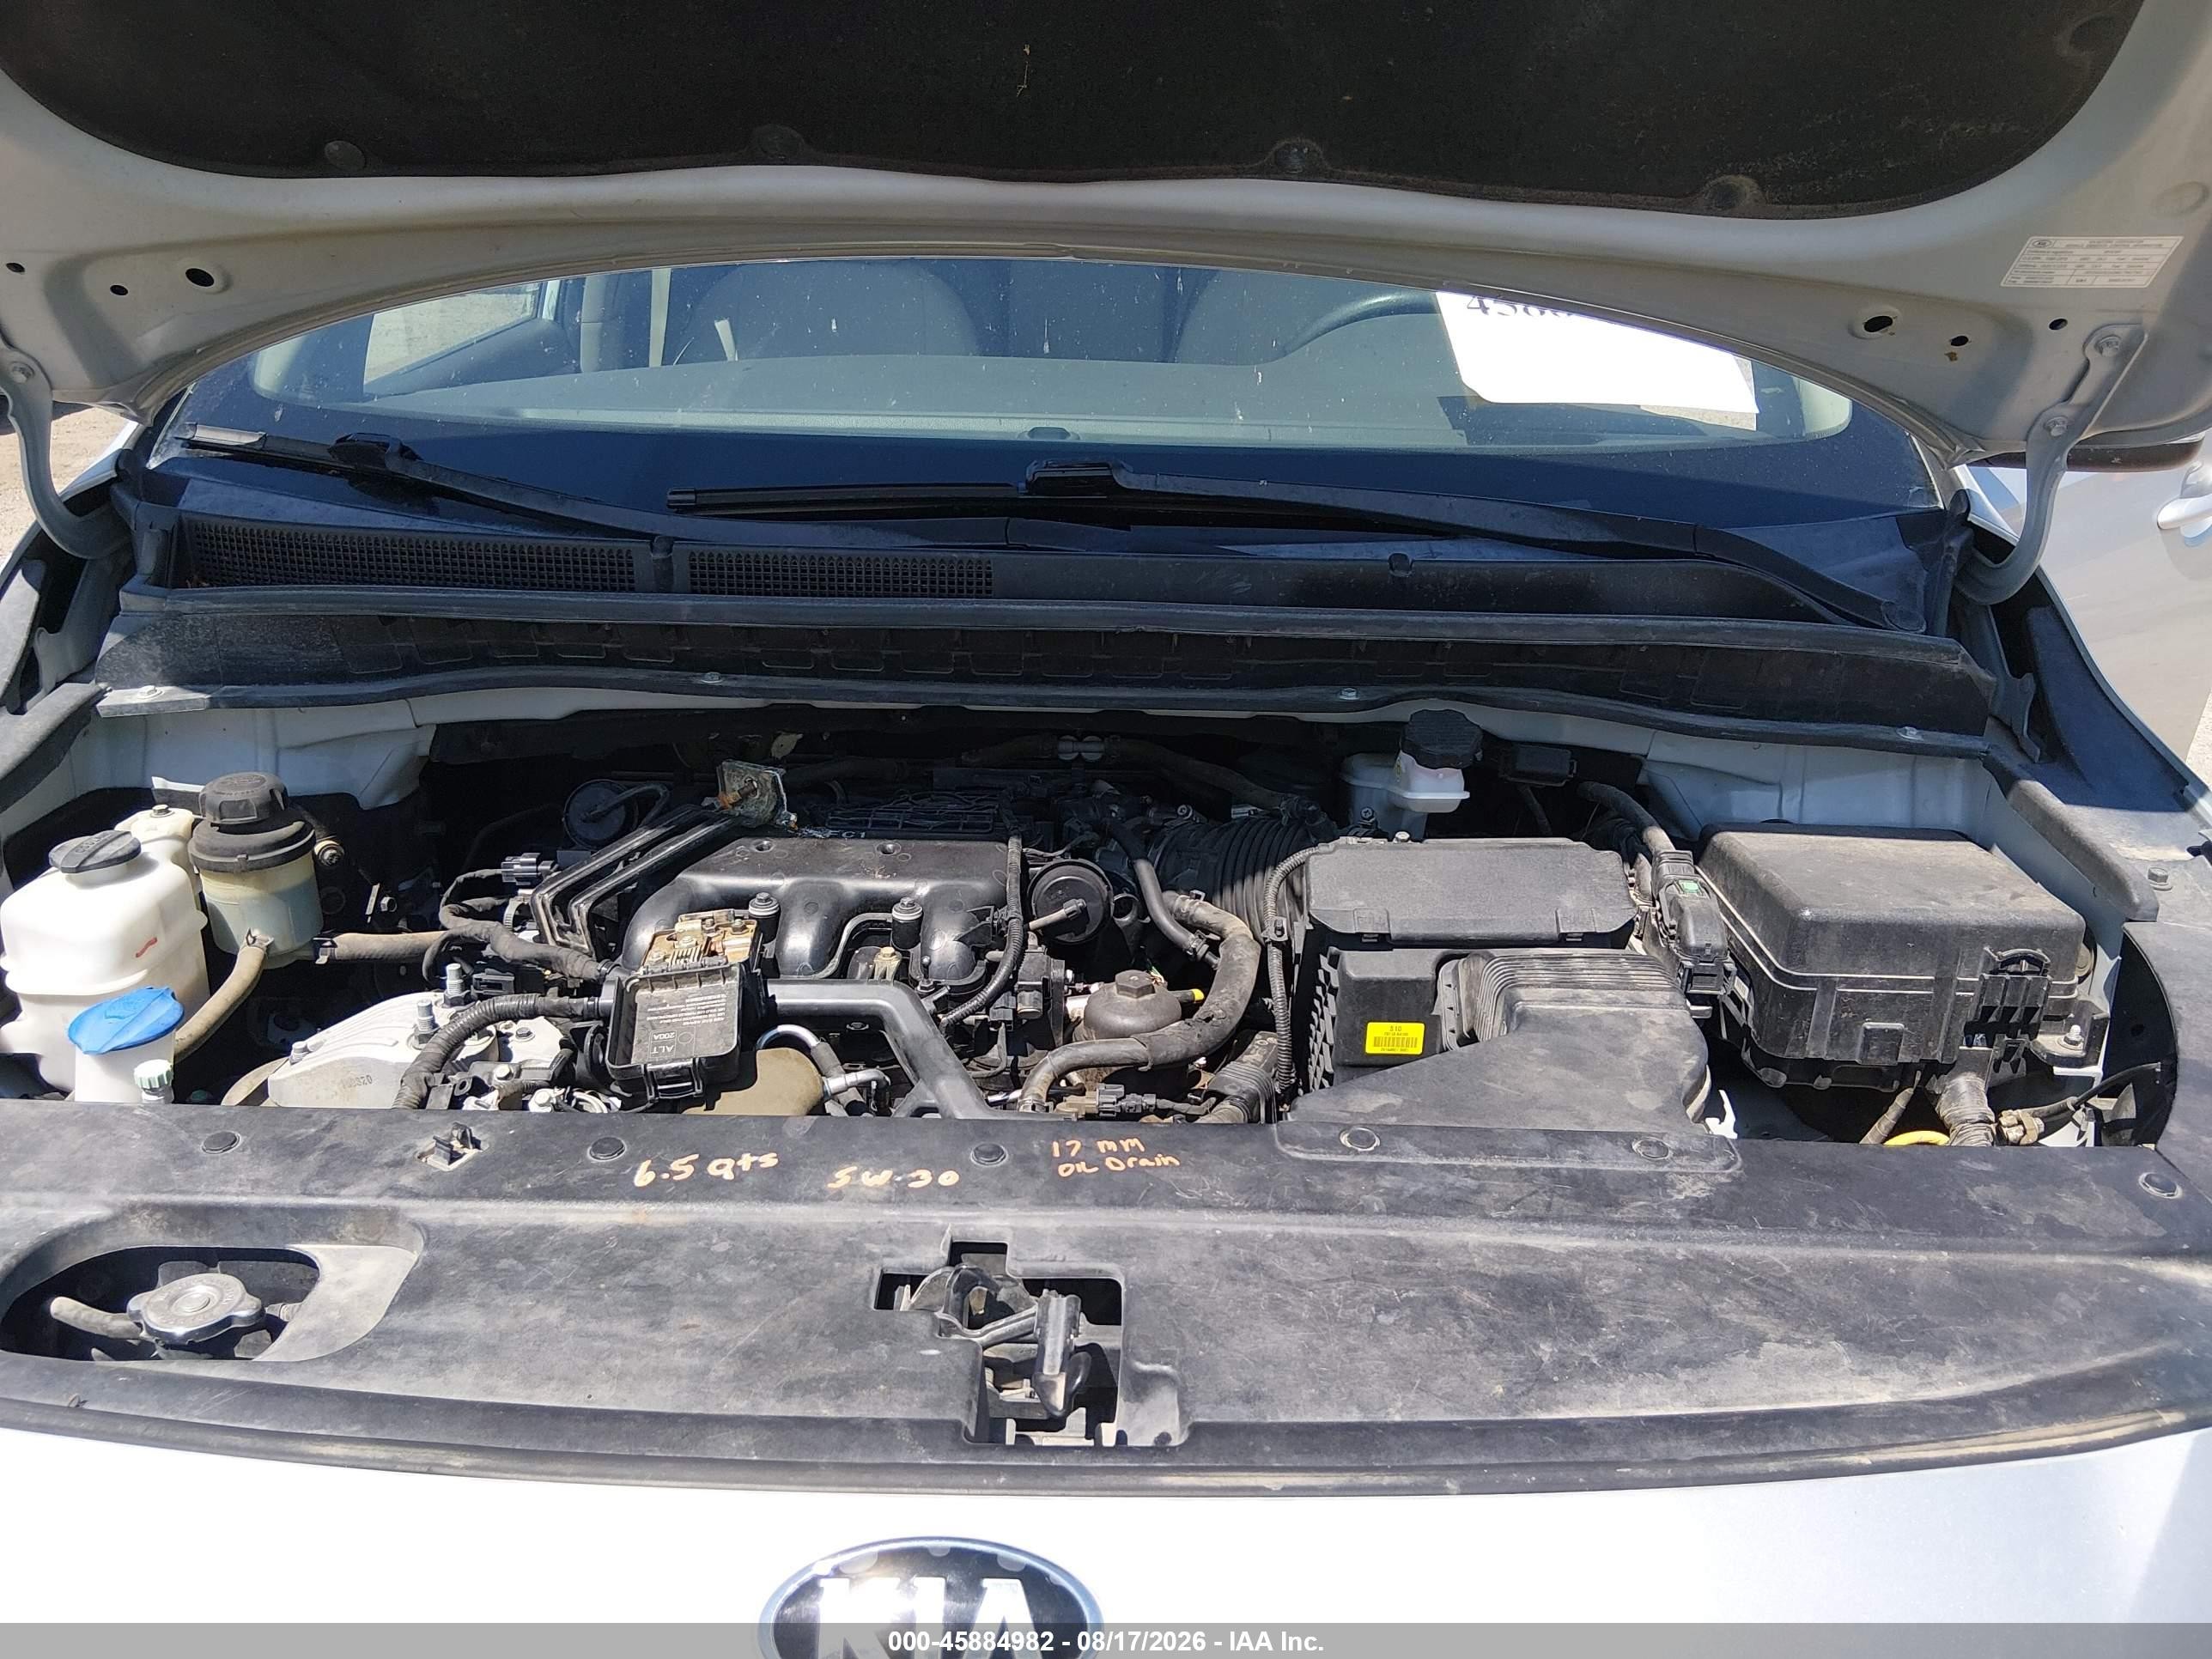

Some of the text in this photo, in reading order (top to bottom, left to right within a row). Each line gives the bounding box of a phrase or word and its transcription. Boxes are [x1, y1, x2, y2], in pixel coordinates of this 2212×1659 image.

[651, 1045, 674, 1054] ALT
[1053, 1139, 1082, 1158] 17
[634, 1153, 700, 1187] 6.5
[817, 1577, 1044, 1659] KIA
